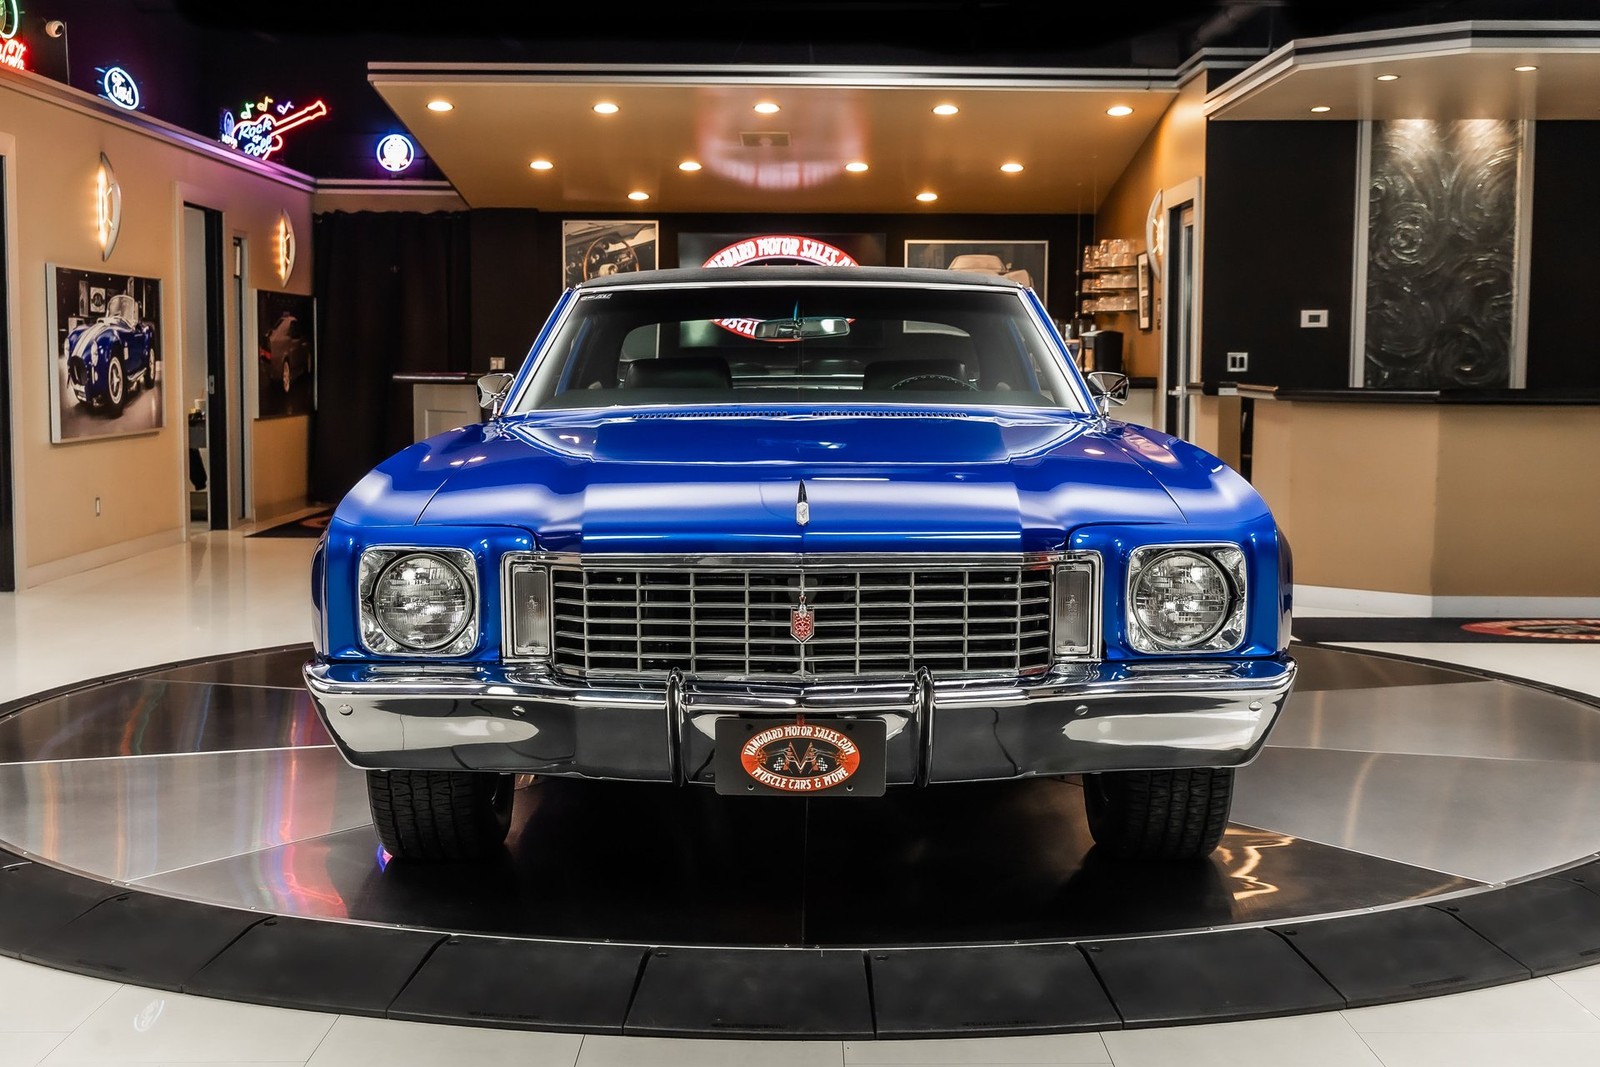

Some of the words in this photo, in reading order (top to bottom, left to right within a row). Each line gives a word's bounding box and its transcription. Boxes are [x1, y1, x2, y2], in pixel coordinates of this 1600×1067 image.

[757, 237, 799, 256] MOTOR
[744, 728, 783, 756] VANGUARD
[784, 726, 812, 737] MOTOR
[813, 727, 856, 755] SALES.COM
[752, 766, 788, 788] MUSCLE
[788, 779, 812, 790] CARS
[814, 778, 822, 788] &
[823, 767, 849, 786] MORE
